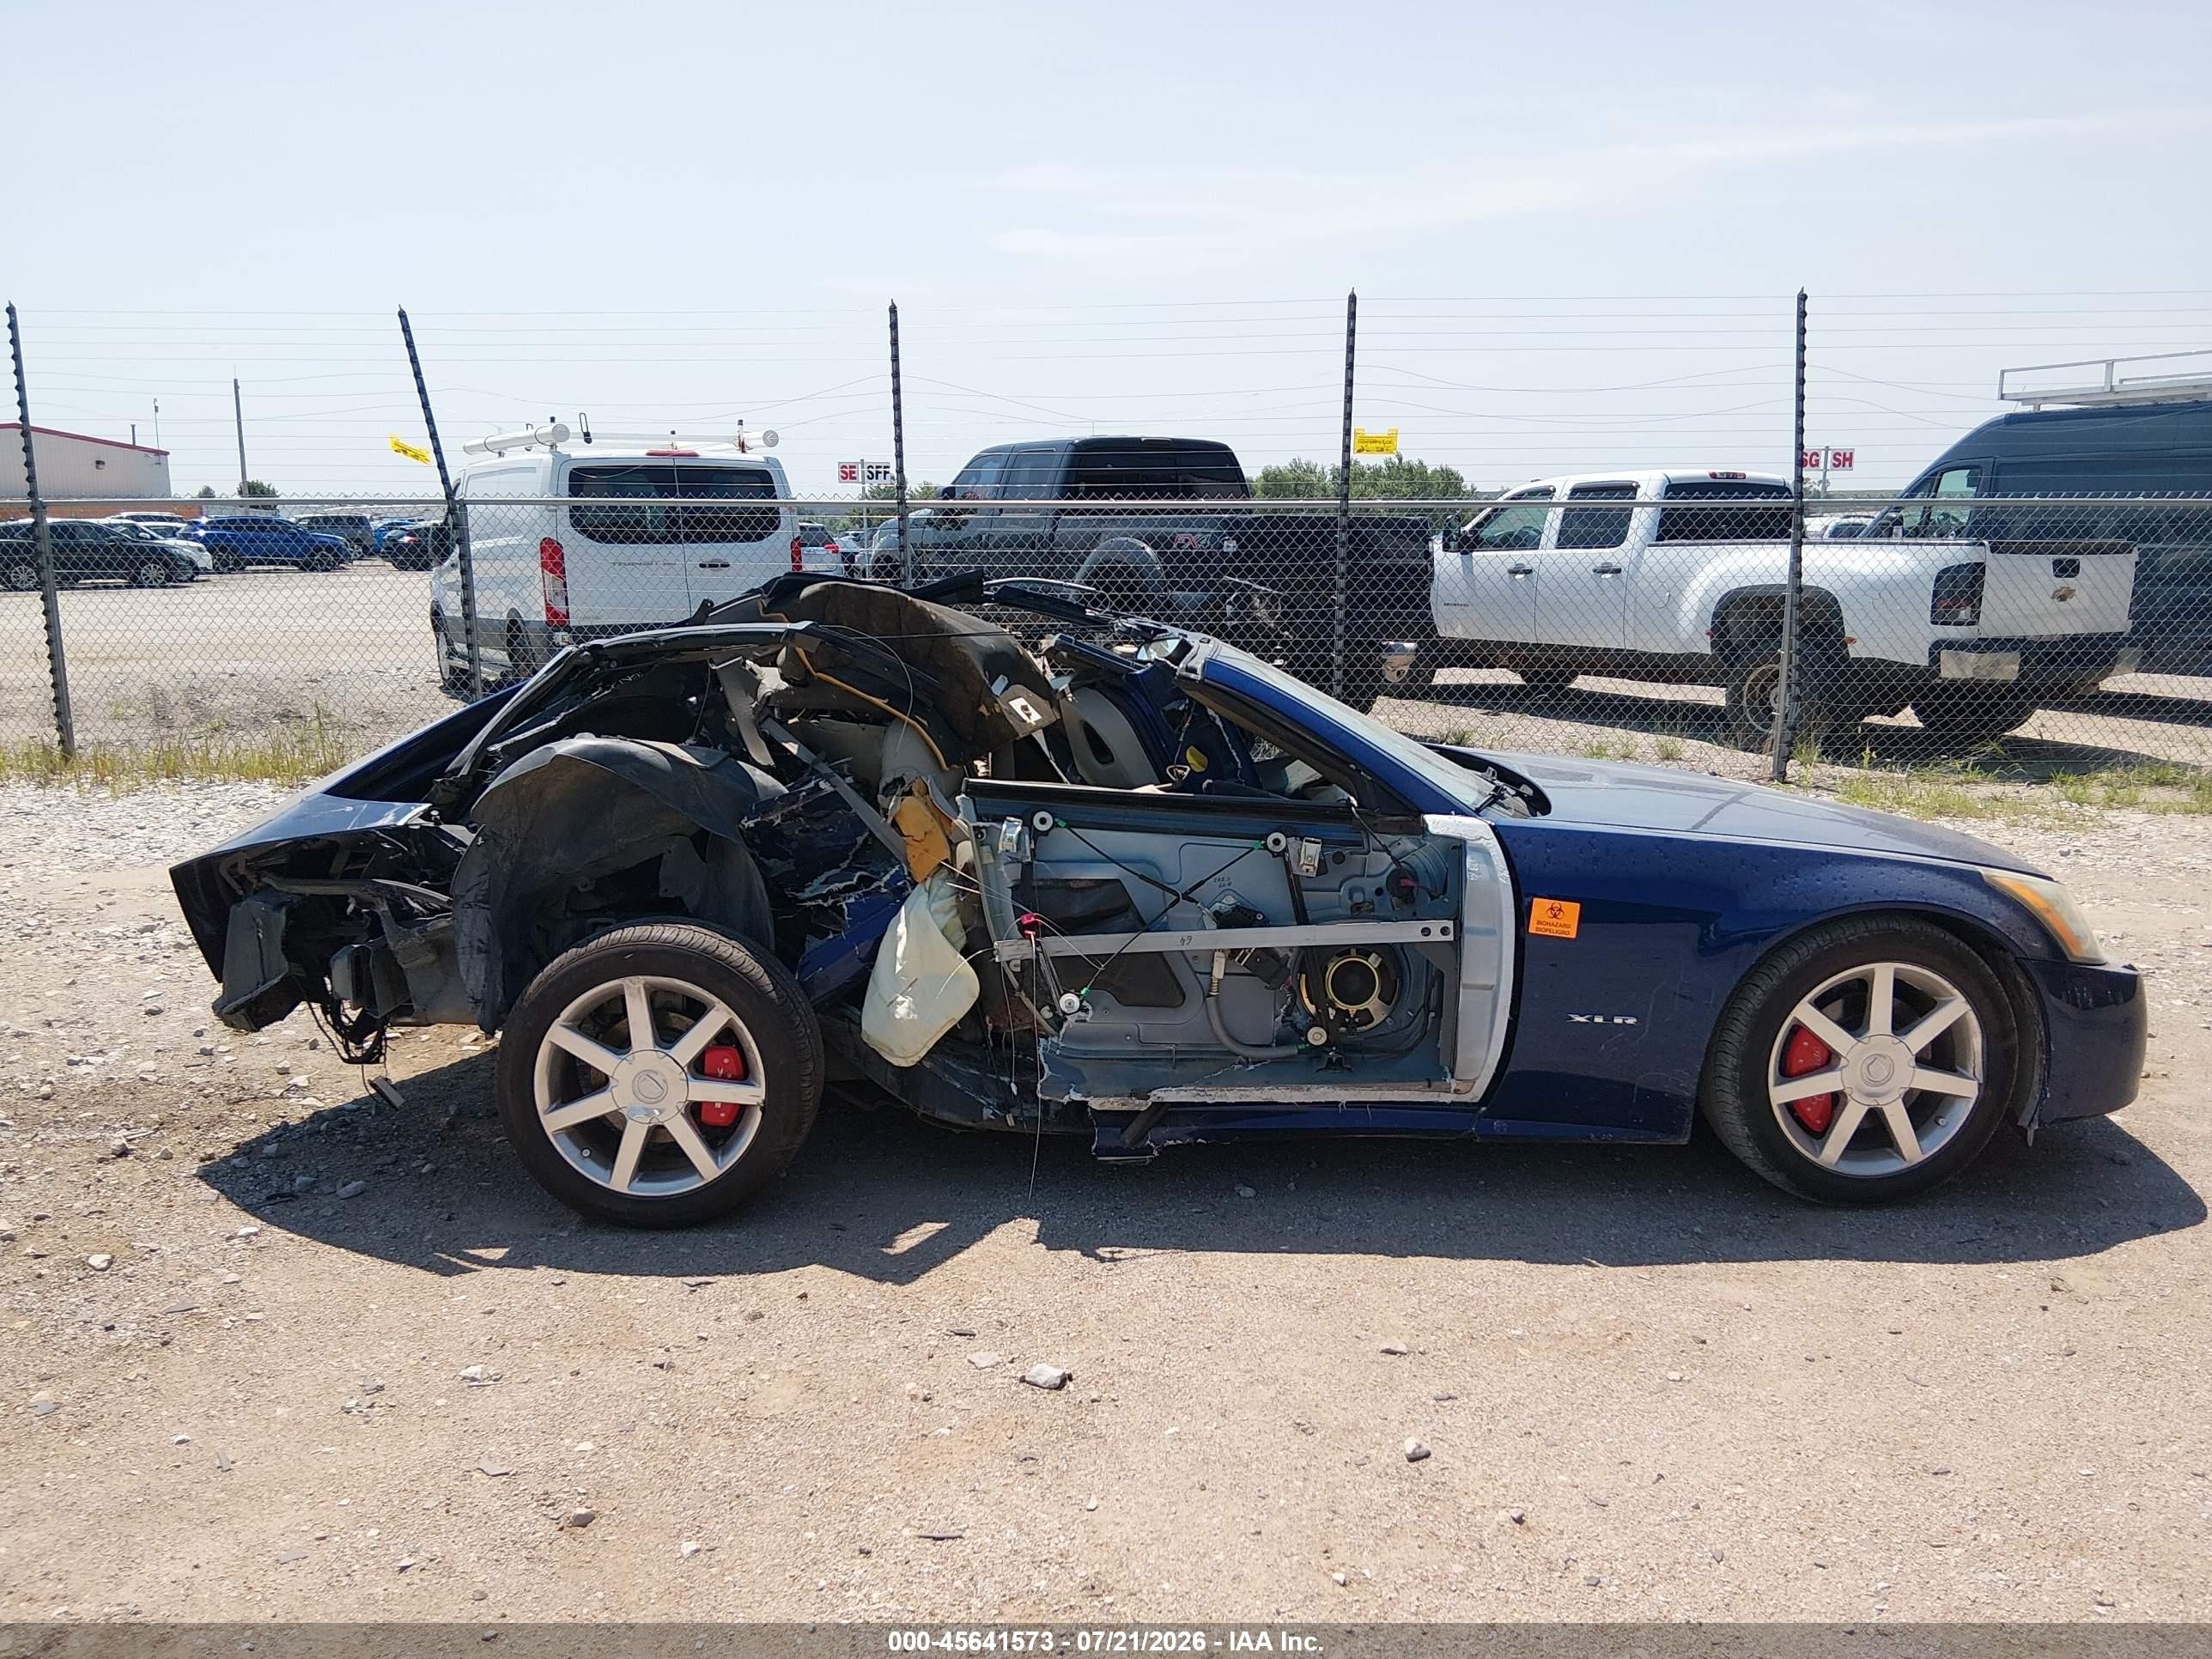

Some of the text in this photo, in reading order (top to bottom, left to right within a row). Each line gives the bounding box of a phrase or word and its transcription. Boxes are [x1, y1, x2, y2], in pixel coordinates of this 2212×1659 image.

[1832, 452, 1853, 468] SH
[840, 465, 857, 480] SE
[866, 465, 890, 480] SFF
[1536, 920, 1571, 928] BIOHAZARD
[1565, 1013, 1637, 1024] XLR
